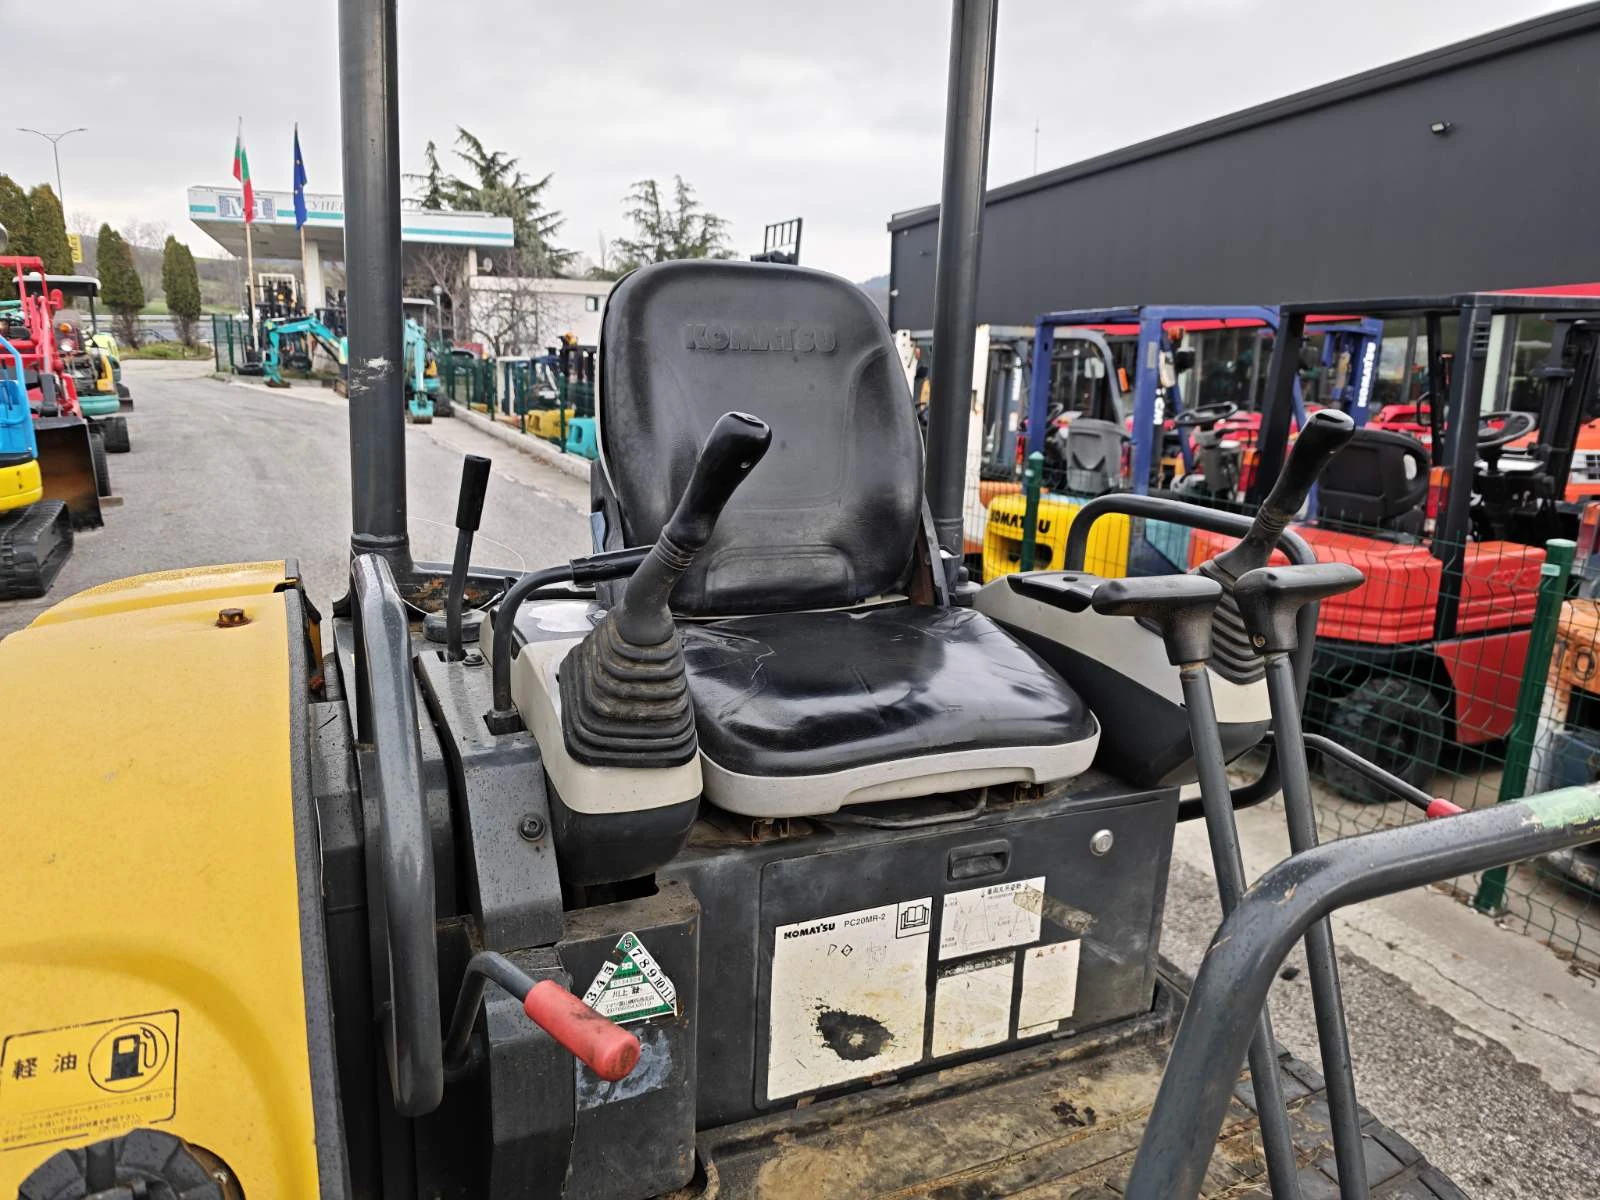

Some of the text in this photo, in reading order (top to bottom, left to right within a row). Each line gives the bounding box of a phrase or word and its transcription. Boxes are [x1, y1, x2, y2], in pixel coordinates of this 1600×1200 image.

[685, 322, 838, 354] KOMATSU
[990, 509, 1051, 534] KOMATU
[784, 913, 886, 939] KOMATSU PC20MR-2
[639, 958, 650, 969] 8
[647, 968, 657, 978] 9
